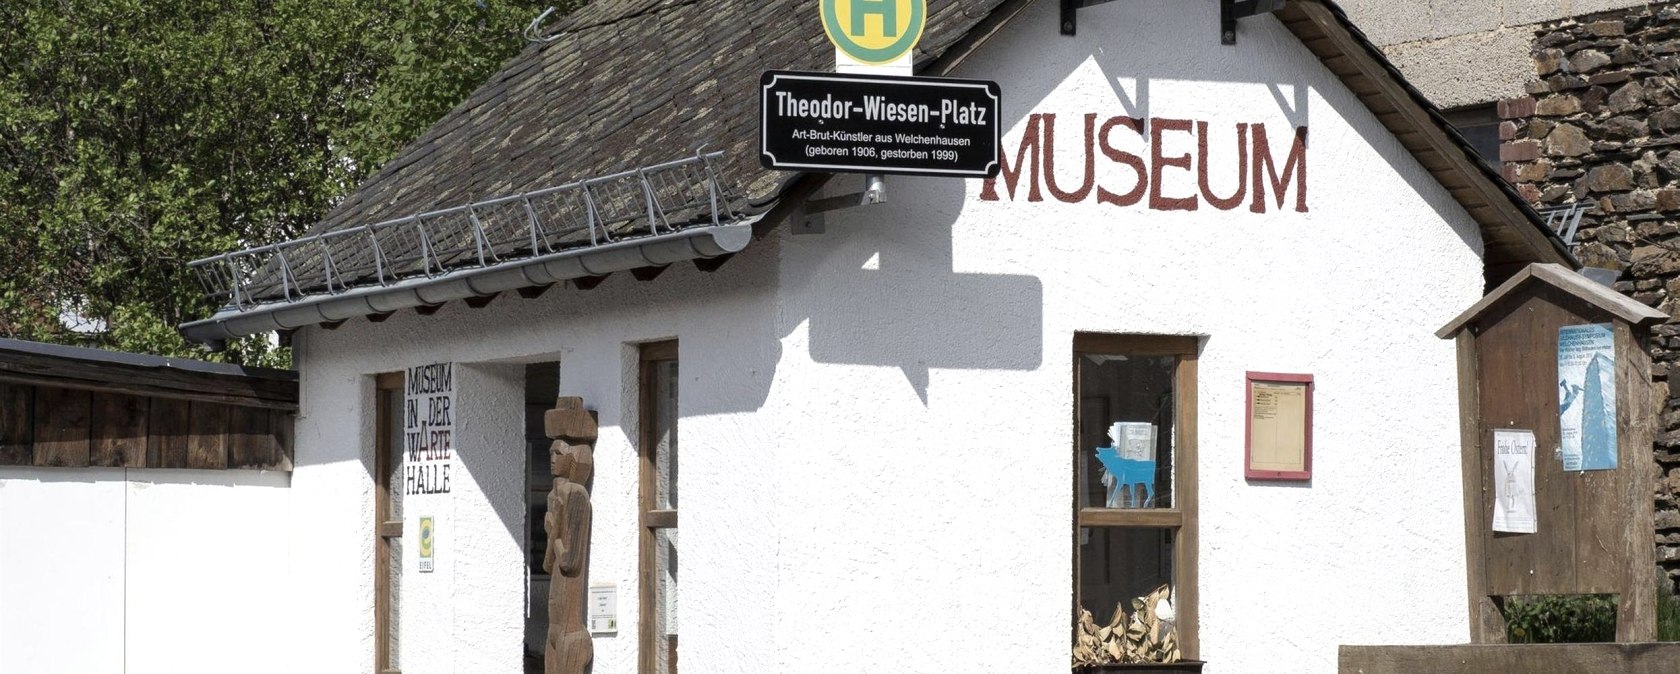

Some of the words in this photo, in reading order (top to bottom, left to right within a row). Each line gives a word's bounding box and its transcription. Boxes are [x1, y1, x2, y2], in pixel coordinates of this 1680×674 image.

[775, 91, 987, 126] Theodor-Wiesen-Platz
[792, 129, 873, 143] Art-Brut-Künstler
[875, 134, 892, 143] aus
[895, 134, 971, 146] Welchenhausen
[805, 146, 849, 157] (geboren
[852, 147, 878, 159] 1906,
[881, 148, 928, 161] gestorben
[931, 149, 959, 162] 1999)
[979, 112, 1309, 214] MUSEUM
[407, 362, 452, 395] MUSEUM
[407, 399, 418, 429] IN
[428, 396, 451, 427] DER
[407, 420, 451, 462] WARTE
[406, 464, 451, 495] HALLE
[419, 561, 432, 570] EIFEL
